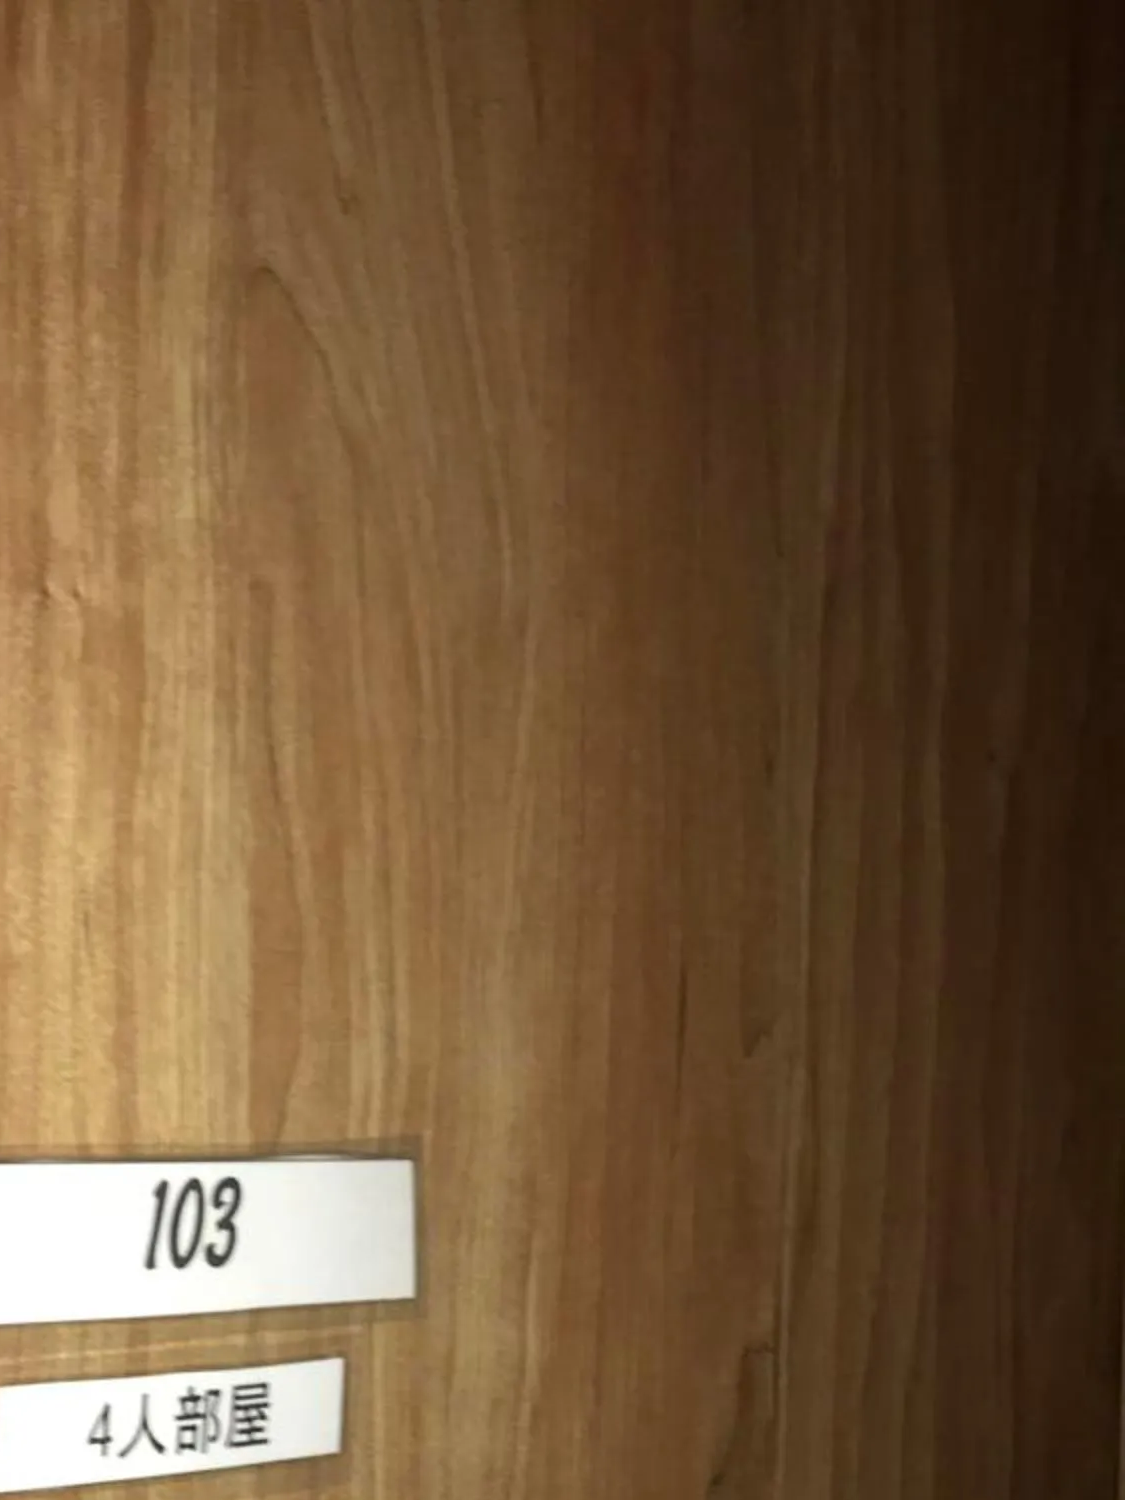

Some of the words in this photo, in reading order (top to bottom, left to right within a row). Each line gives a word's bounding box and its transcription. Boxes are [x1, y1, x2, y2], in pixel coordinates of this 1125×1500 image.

[144, 1176, 242, 1270] 103
[88, 1382, 271, 1458] 4人部屋
